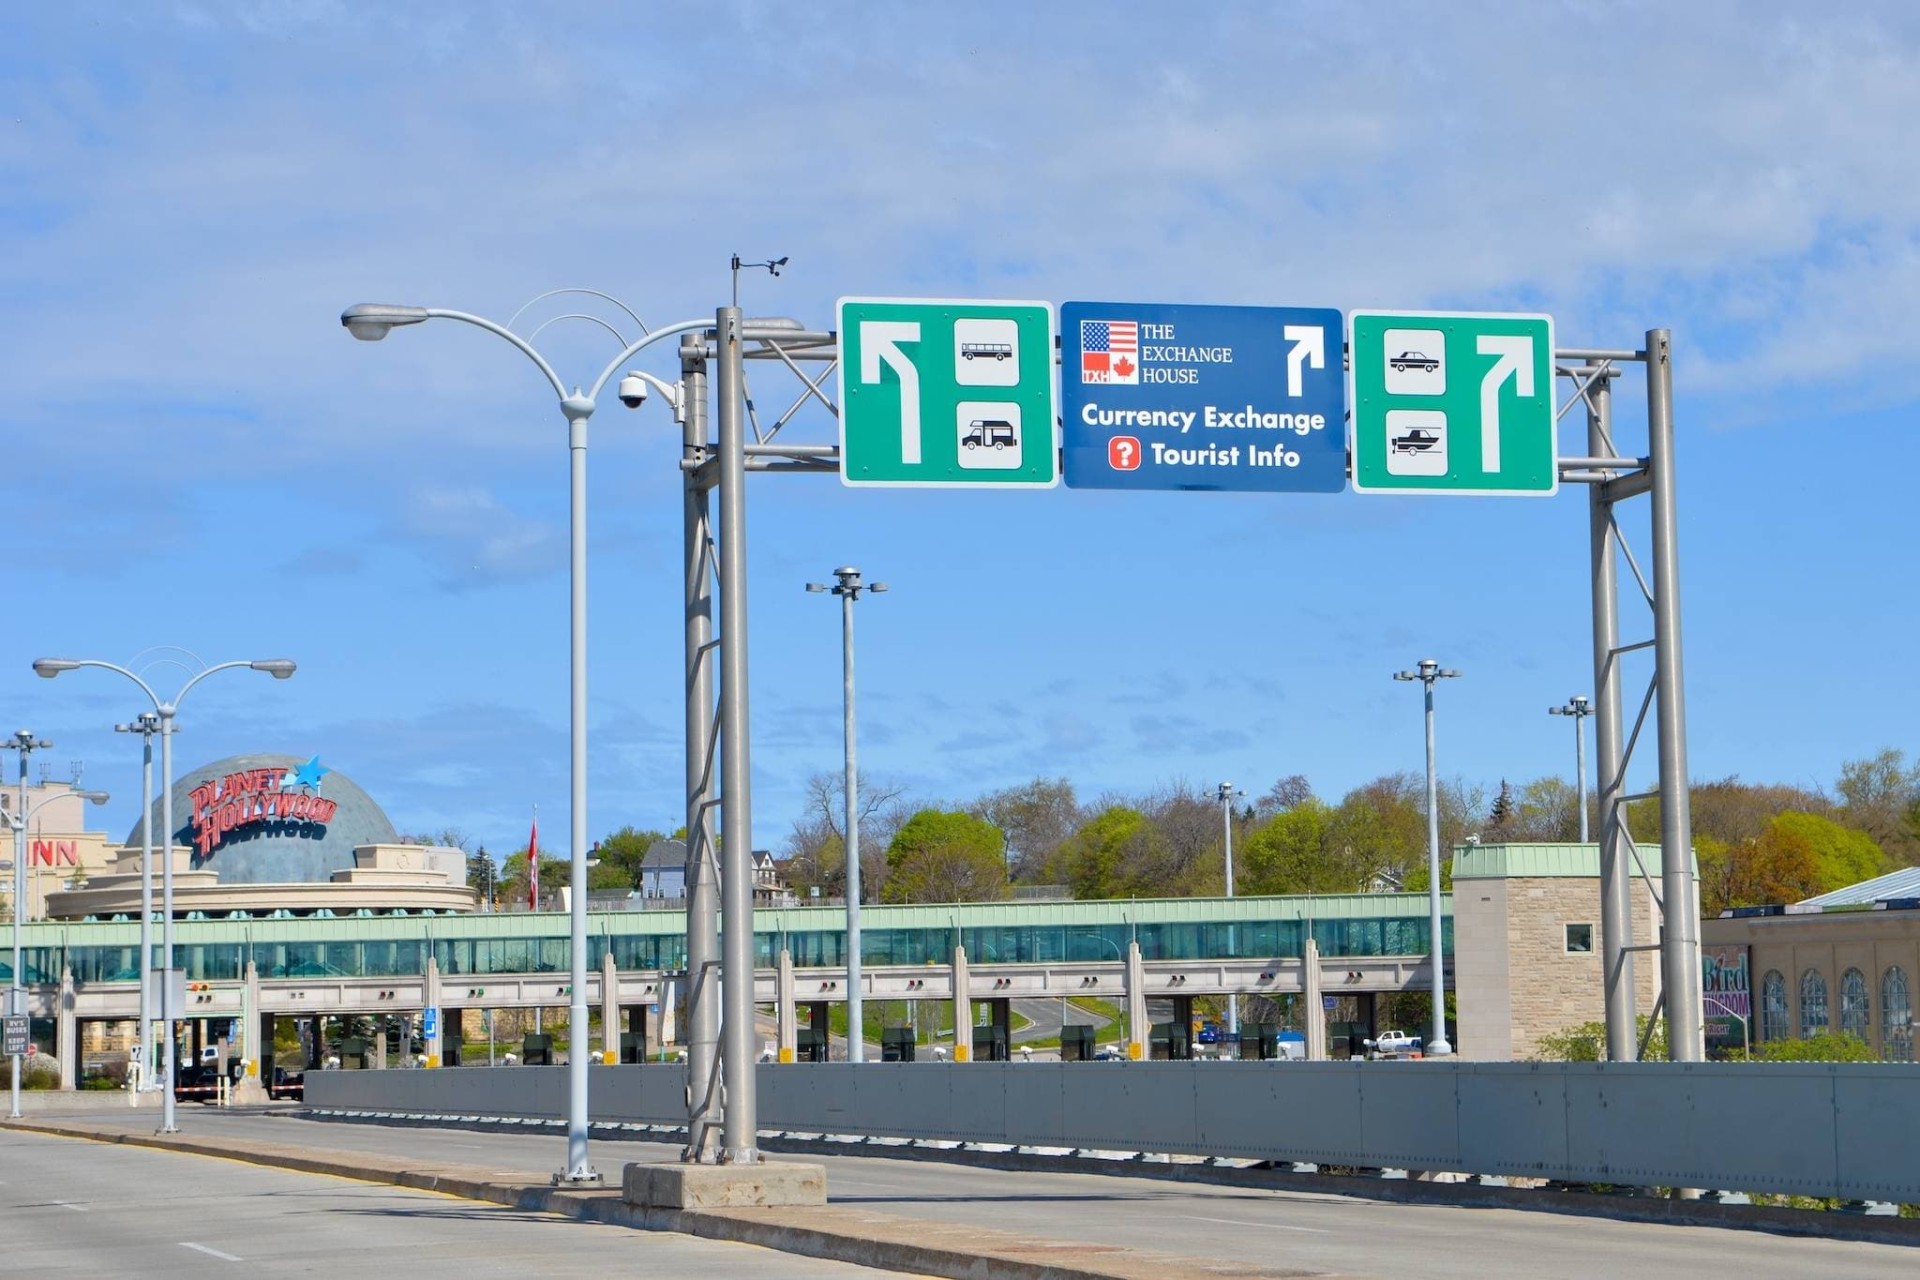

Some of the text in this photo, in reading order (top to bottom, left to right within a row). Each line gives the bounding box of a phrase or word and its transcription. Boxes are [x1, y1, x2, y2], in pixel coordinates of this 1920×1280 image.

[1141, 324, 1175, 340] THE
[1142, 346, 1233, 363] EXCHANGE
[1084, 370, 1109, 382] TXH
[1142, 368, 1199, 384] HOUSE
[1081, 402, 1326, 436] Currency Exchange
[1150, 442, 1240, 466] Tourist
[1249, 443, 1300, 468] Info
[188, 767, 289, 828] PLANET
[193, 793, 338, 858] HOLLYWOOD
